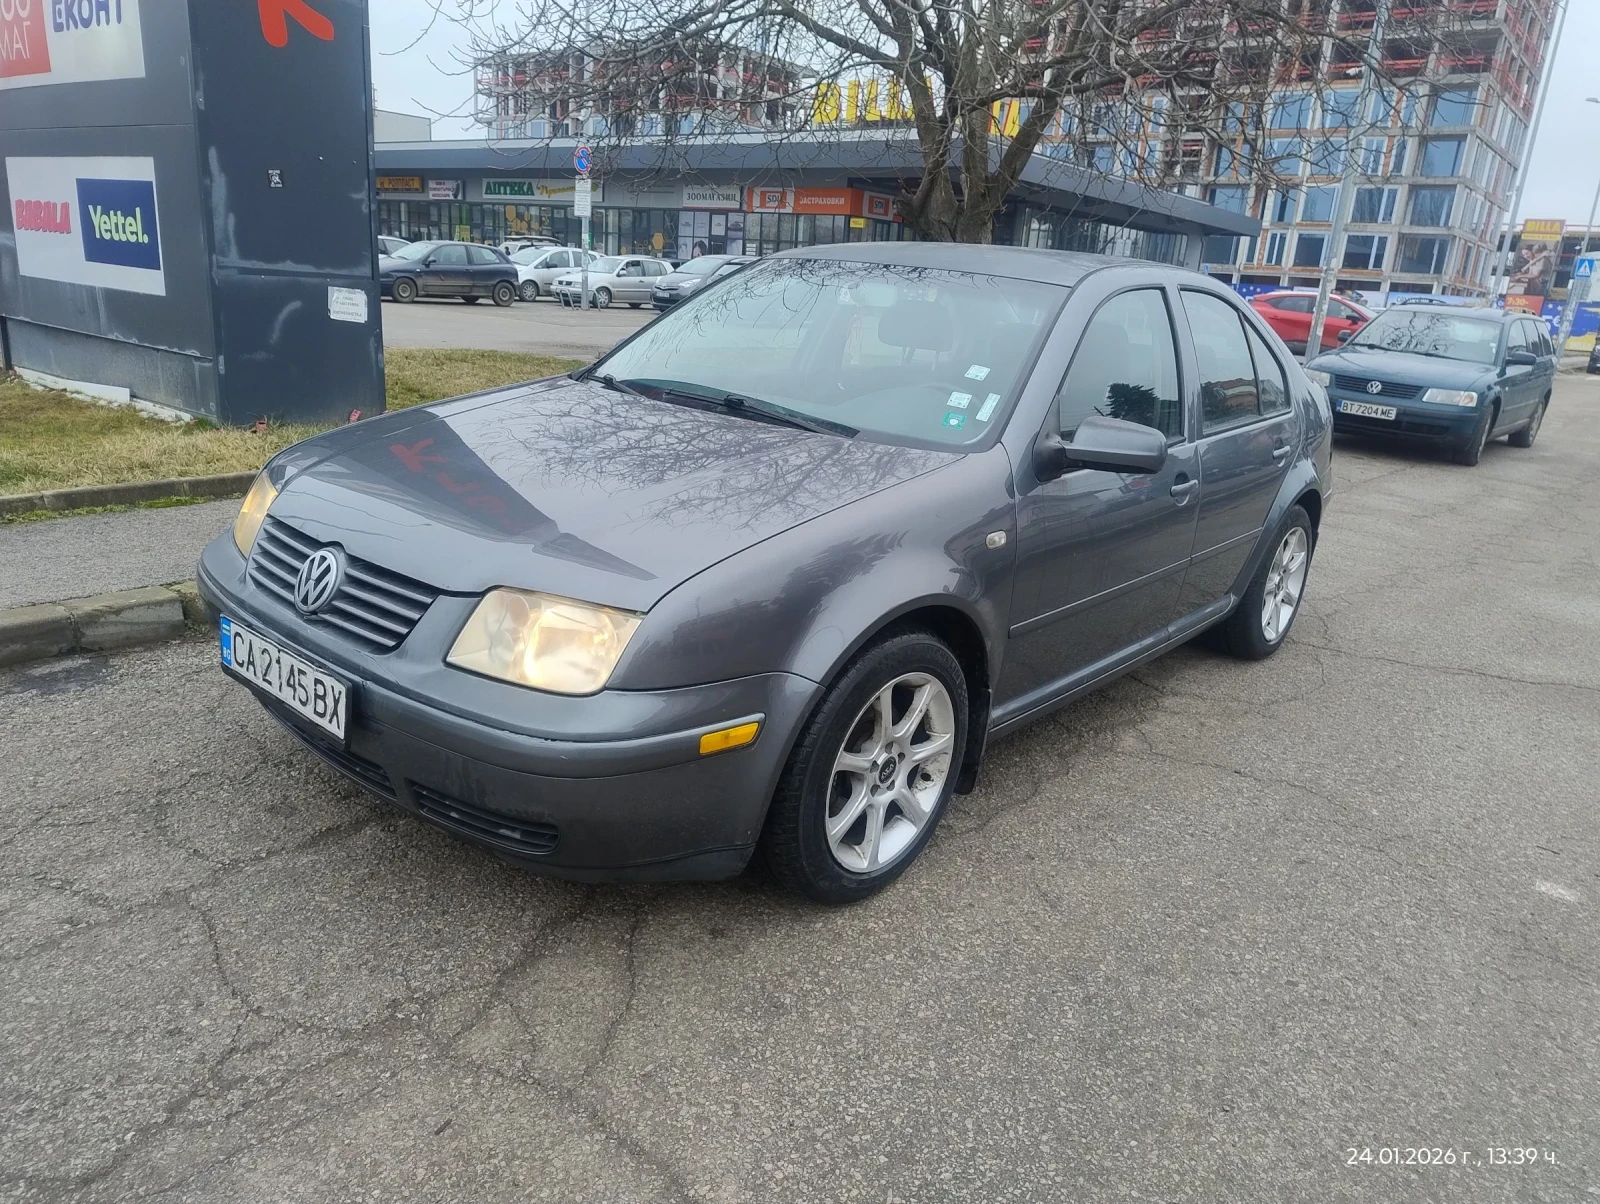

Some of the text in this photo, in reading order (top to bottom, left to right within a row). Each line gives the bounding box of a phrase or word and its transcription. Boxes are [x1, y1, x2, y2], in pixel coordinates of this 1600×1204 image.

[484, 181, 535, 196] АПТЕКА
[15, 199, 71, 234] BABALA
[88, 204, 149, 244] Yettel.
